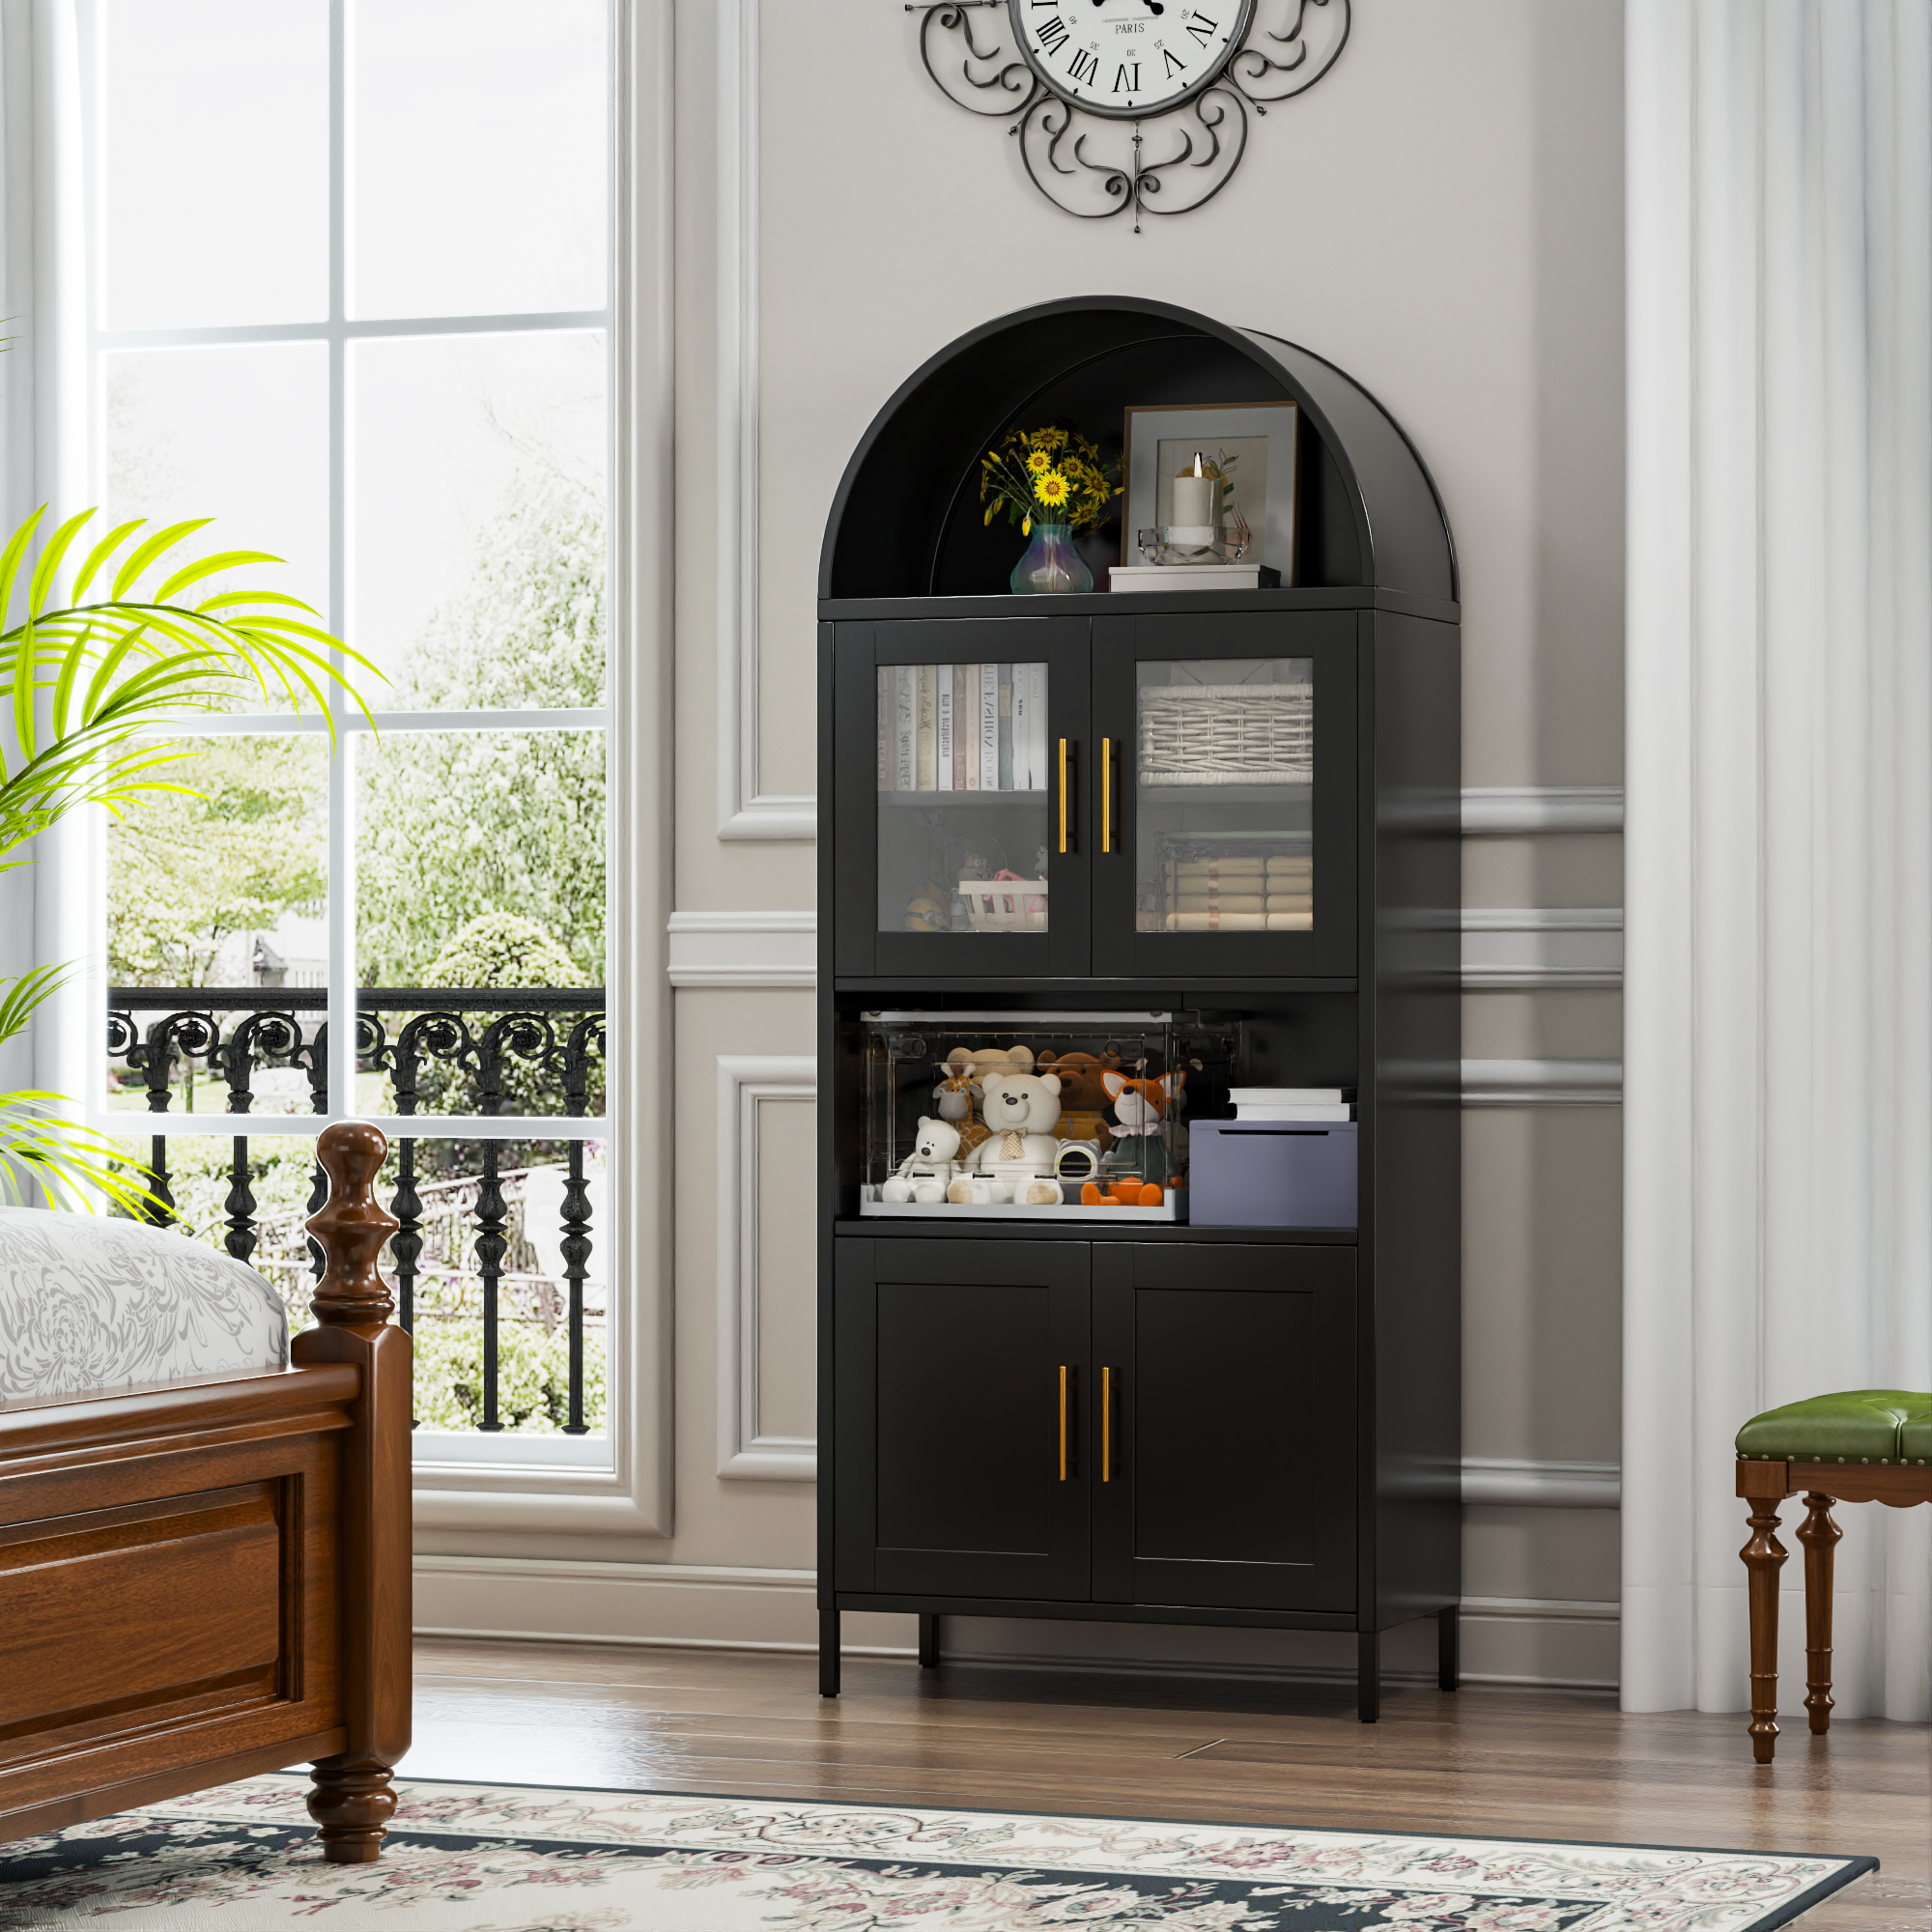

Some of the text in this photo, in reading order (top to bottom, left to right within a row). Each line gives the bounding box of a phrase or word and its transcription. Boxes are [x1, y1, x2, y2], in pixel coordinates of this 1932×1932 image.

[1180, 8, 1190, 20] 20
[1115, 23, 1145, 34] PARIS
[1036, 15, 1069, 57] VIII
[1090, 41, 1100, 51] 35
[1153, 39, 1165, 49] 25
[1066, 48, 1098, 87] VII
[1163, 49, 1187, 80] V
